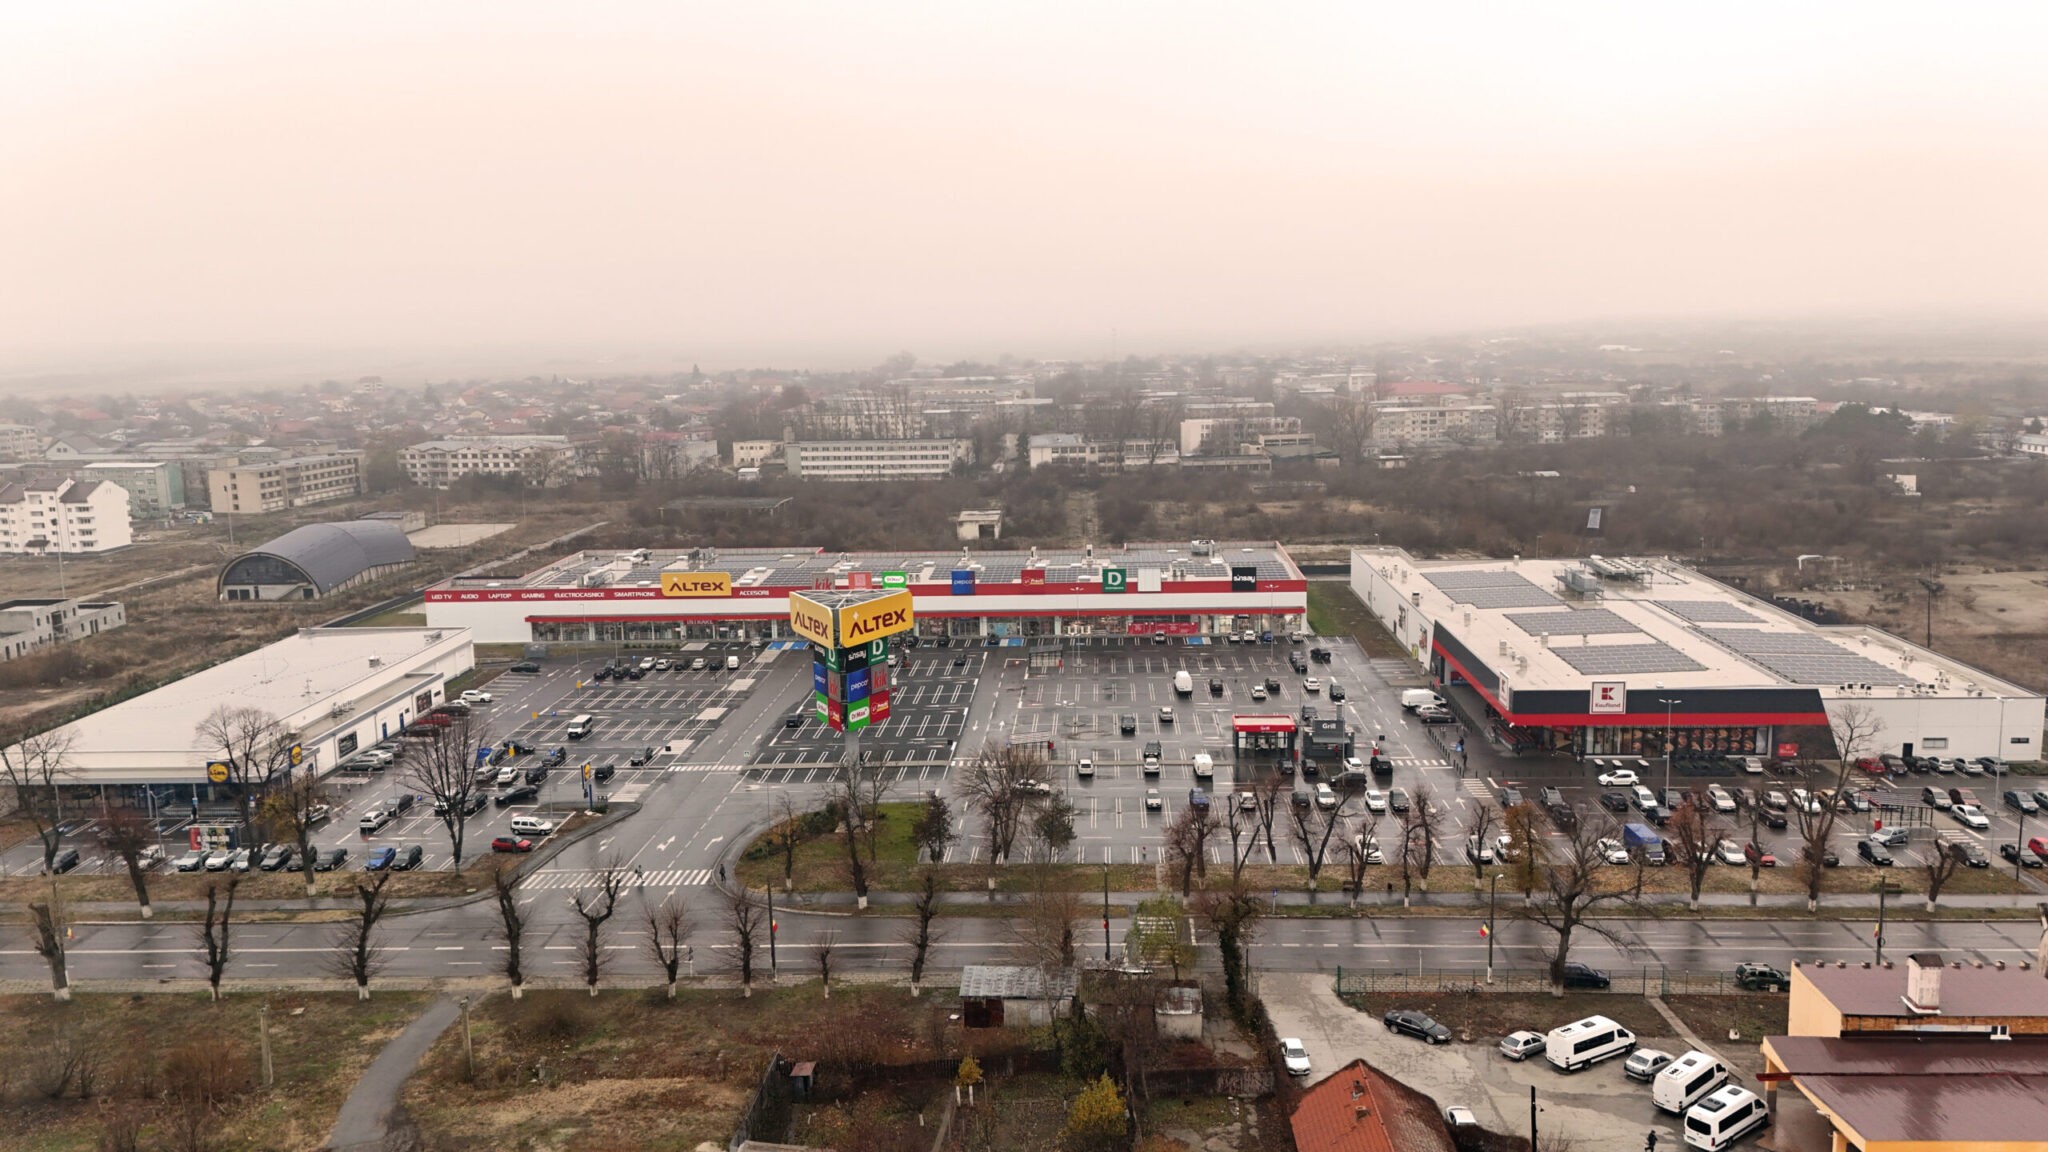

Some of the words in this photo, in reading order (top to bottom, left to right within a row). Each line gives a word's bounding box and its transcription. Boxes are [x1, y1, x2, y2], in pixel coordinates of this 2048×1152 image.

[1107, 572, 1122, 585] D
[1233, 574, 1256, 583] sinsay
[849, 608, 906, 638] ALTEX
[872, 639, 884, 656] D
[848, 649, 867, 661] sinsay
[850, 679, 869, 691] pepco
[873, 670, 887, 689] kik
